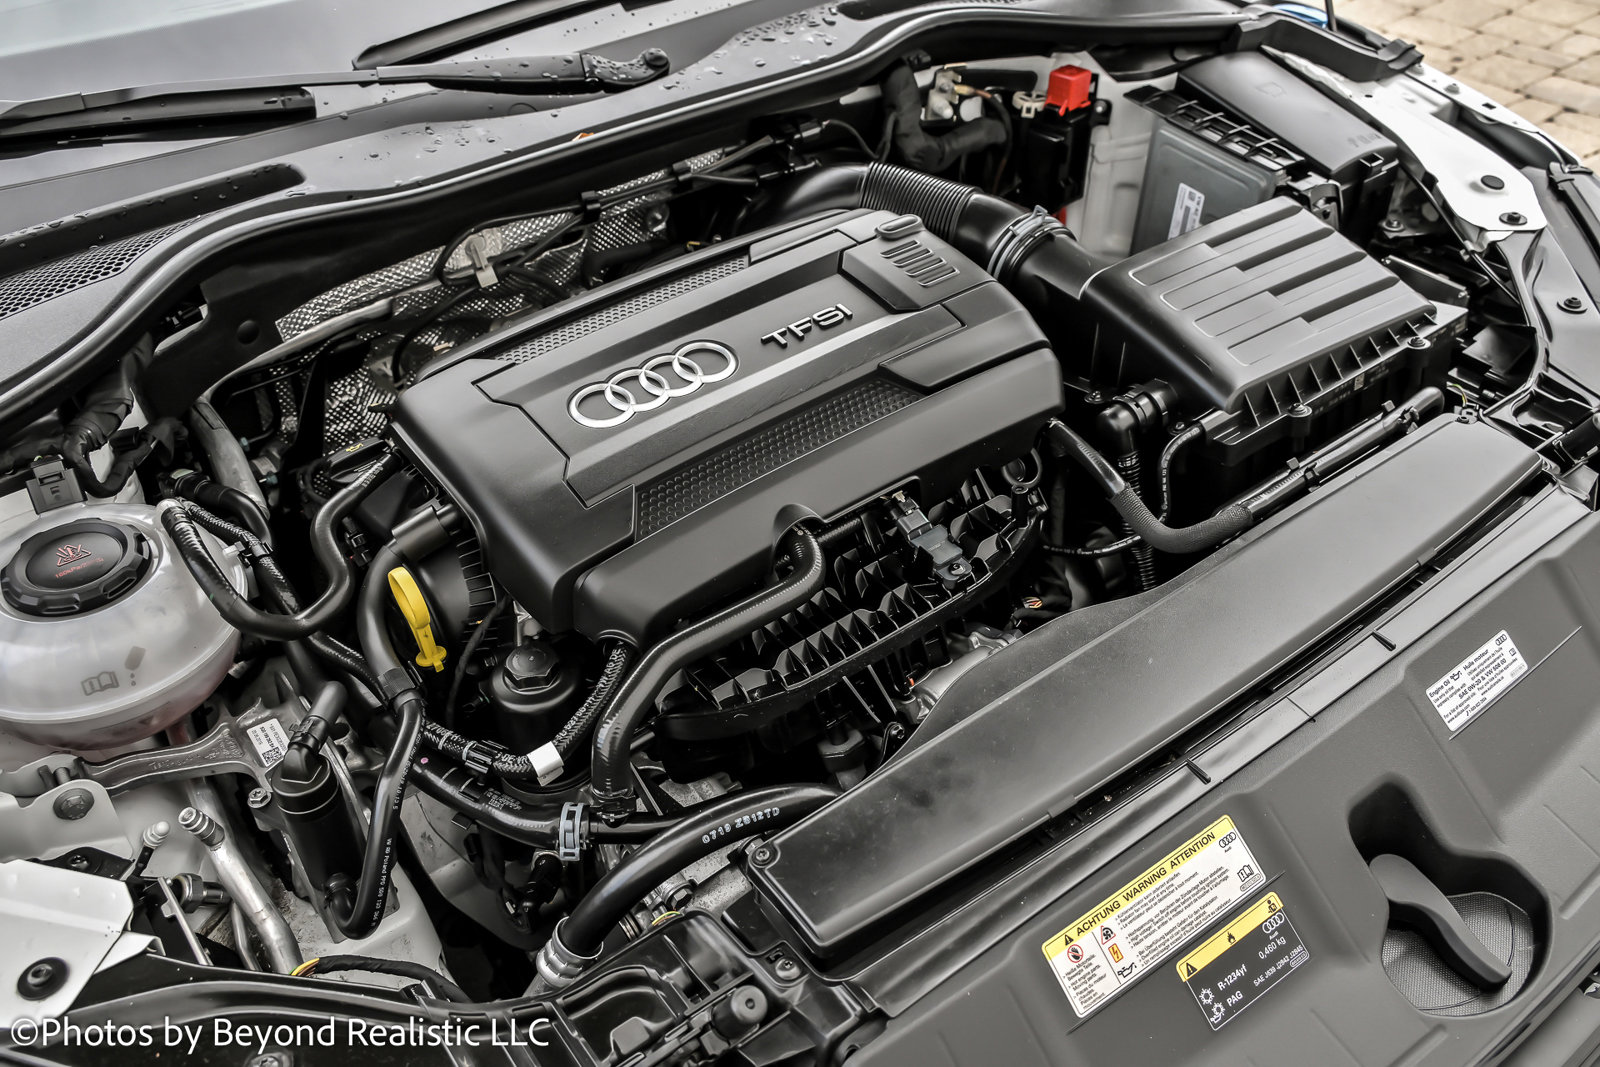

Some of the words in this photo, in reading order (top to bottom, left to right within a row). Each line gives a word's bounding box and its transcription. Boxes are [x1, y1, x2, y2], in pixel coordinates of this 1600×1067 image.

[761, 303, 853, 349] TFSI
[1462, 660, 1474, 670] Huile
[1473, 649, 1489, 662] moteur
[1428, 684, 1444, 698] Engine
[1442, 678, 1450, 686] Oil
[1458, 688, 1468, 698] SAE
[1467, 678, 1481, 691] 0W-20
[1484, 668, 1493, 677] VW
[1492, 662, 1501, 671] 508
[382, 854, 390, 874] Poland
[1075, 899, 1120, 936] ACHTUNG
[1123, 866, 1166, 901] WARNING
[1168, 831, 1215, 868] ATTENTION
[1268, 930, 1278, 940] Audi
[1258, 941, 1277, 960] 0,460
[1275, 934, 1286, 947] kg
[1217, 964, 1247, 991] R-1234yf
[1226, 990, 1242, 1006] PAG
